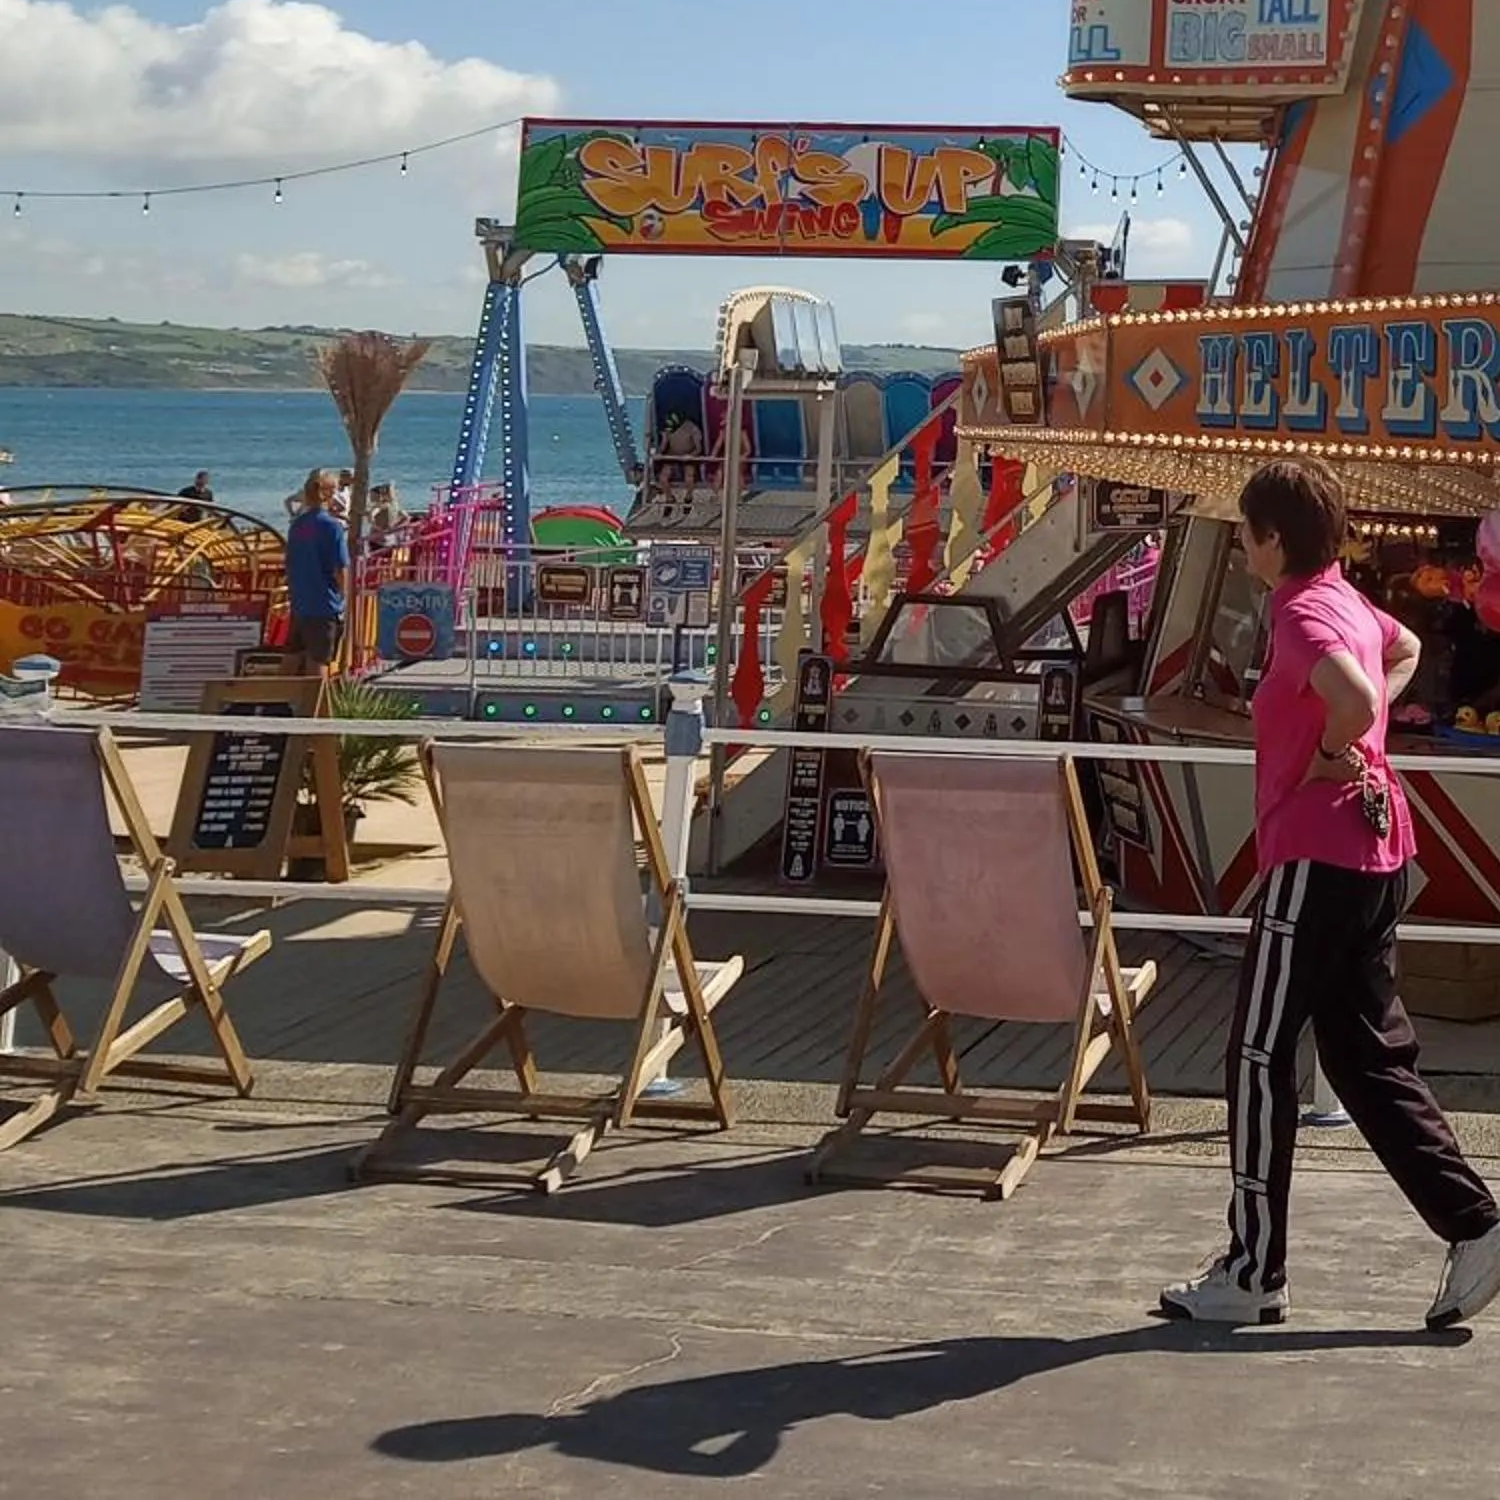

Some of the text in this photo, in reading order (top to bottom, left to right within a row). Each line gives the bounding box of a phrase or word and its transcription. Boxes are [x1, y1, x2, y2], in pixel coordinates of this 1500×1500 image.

[1168, 10, 1324, 63] BIG SMALL
[877, 140, 998, 214] UP
